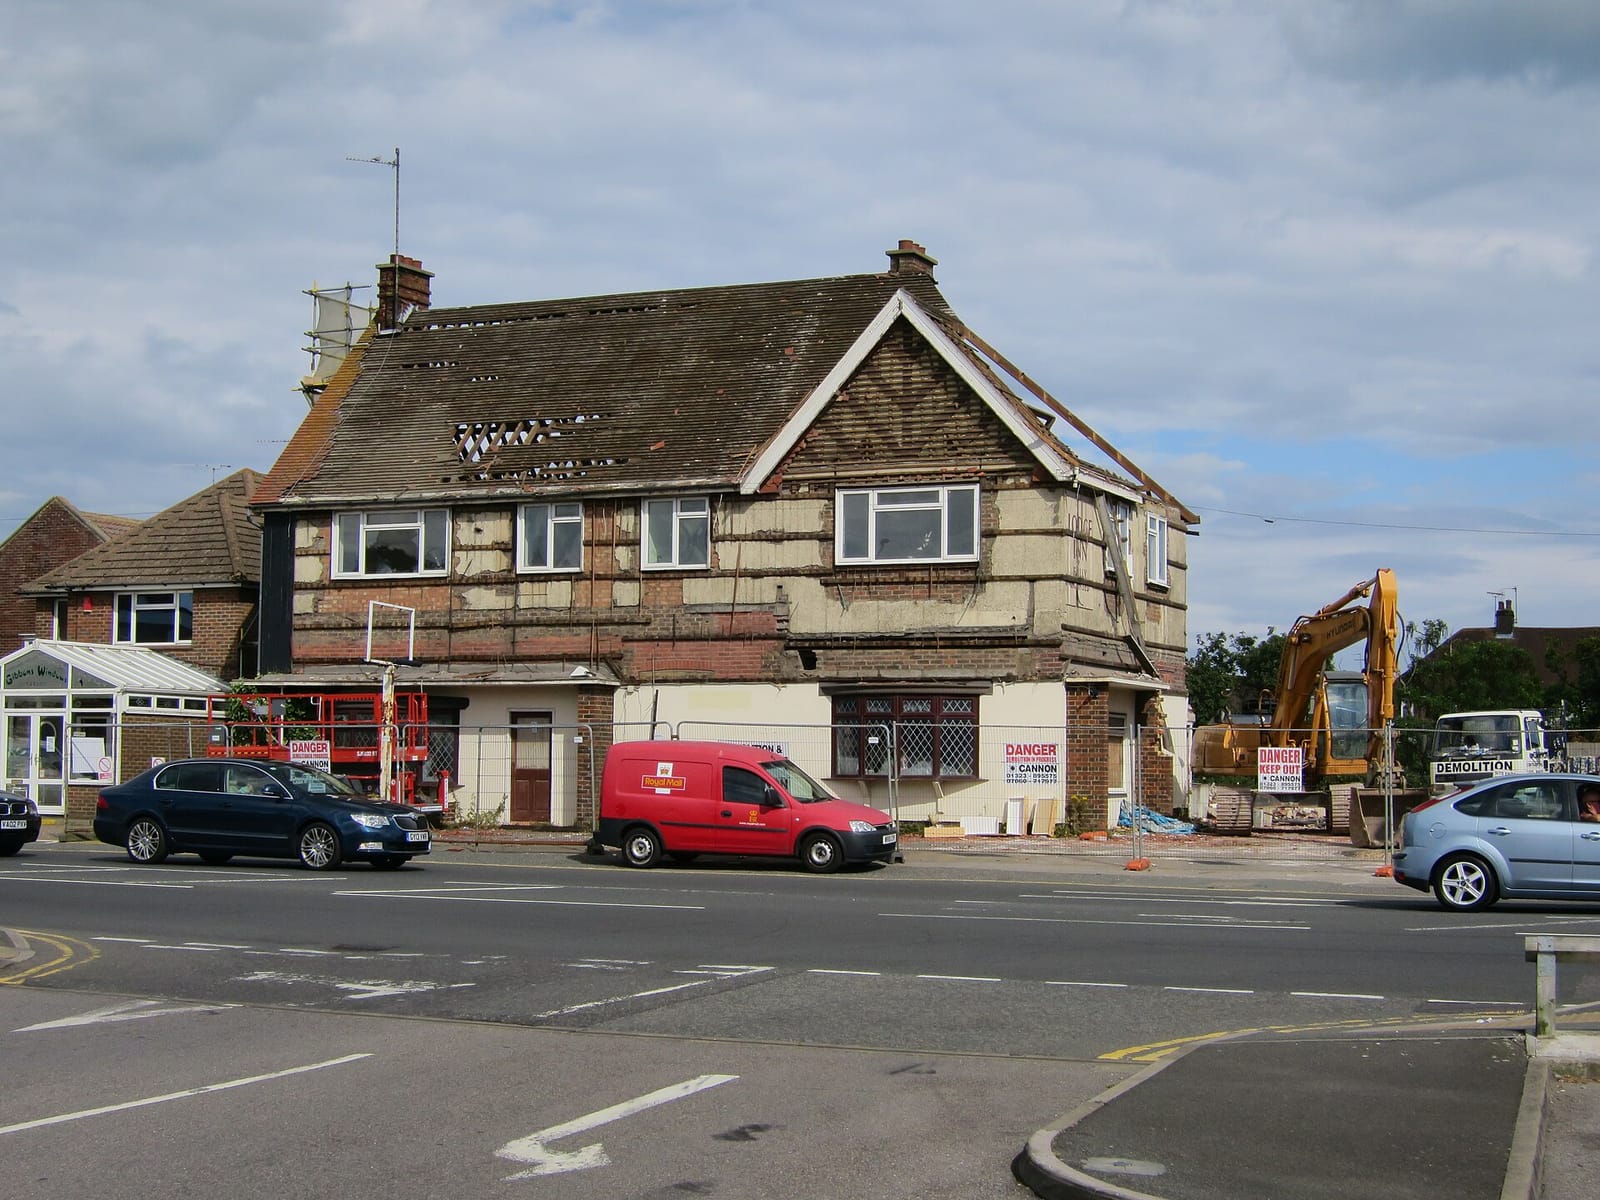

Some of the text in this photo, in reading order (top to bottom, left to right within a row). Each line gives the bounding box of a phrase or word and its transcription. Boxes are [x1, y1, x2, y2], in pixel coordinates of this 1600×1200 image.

[292, 743, 328, 753] DANGER
[1006, 744, 1057, 756] DANGER
[1259, 749, 1301, 763] DANGER
[1259, 765, 1301, 774] KEEP OUT
[1437, 761, 1513, 773] DEMOLITION
[644, 777, 684, 788] Royal Mail
